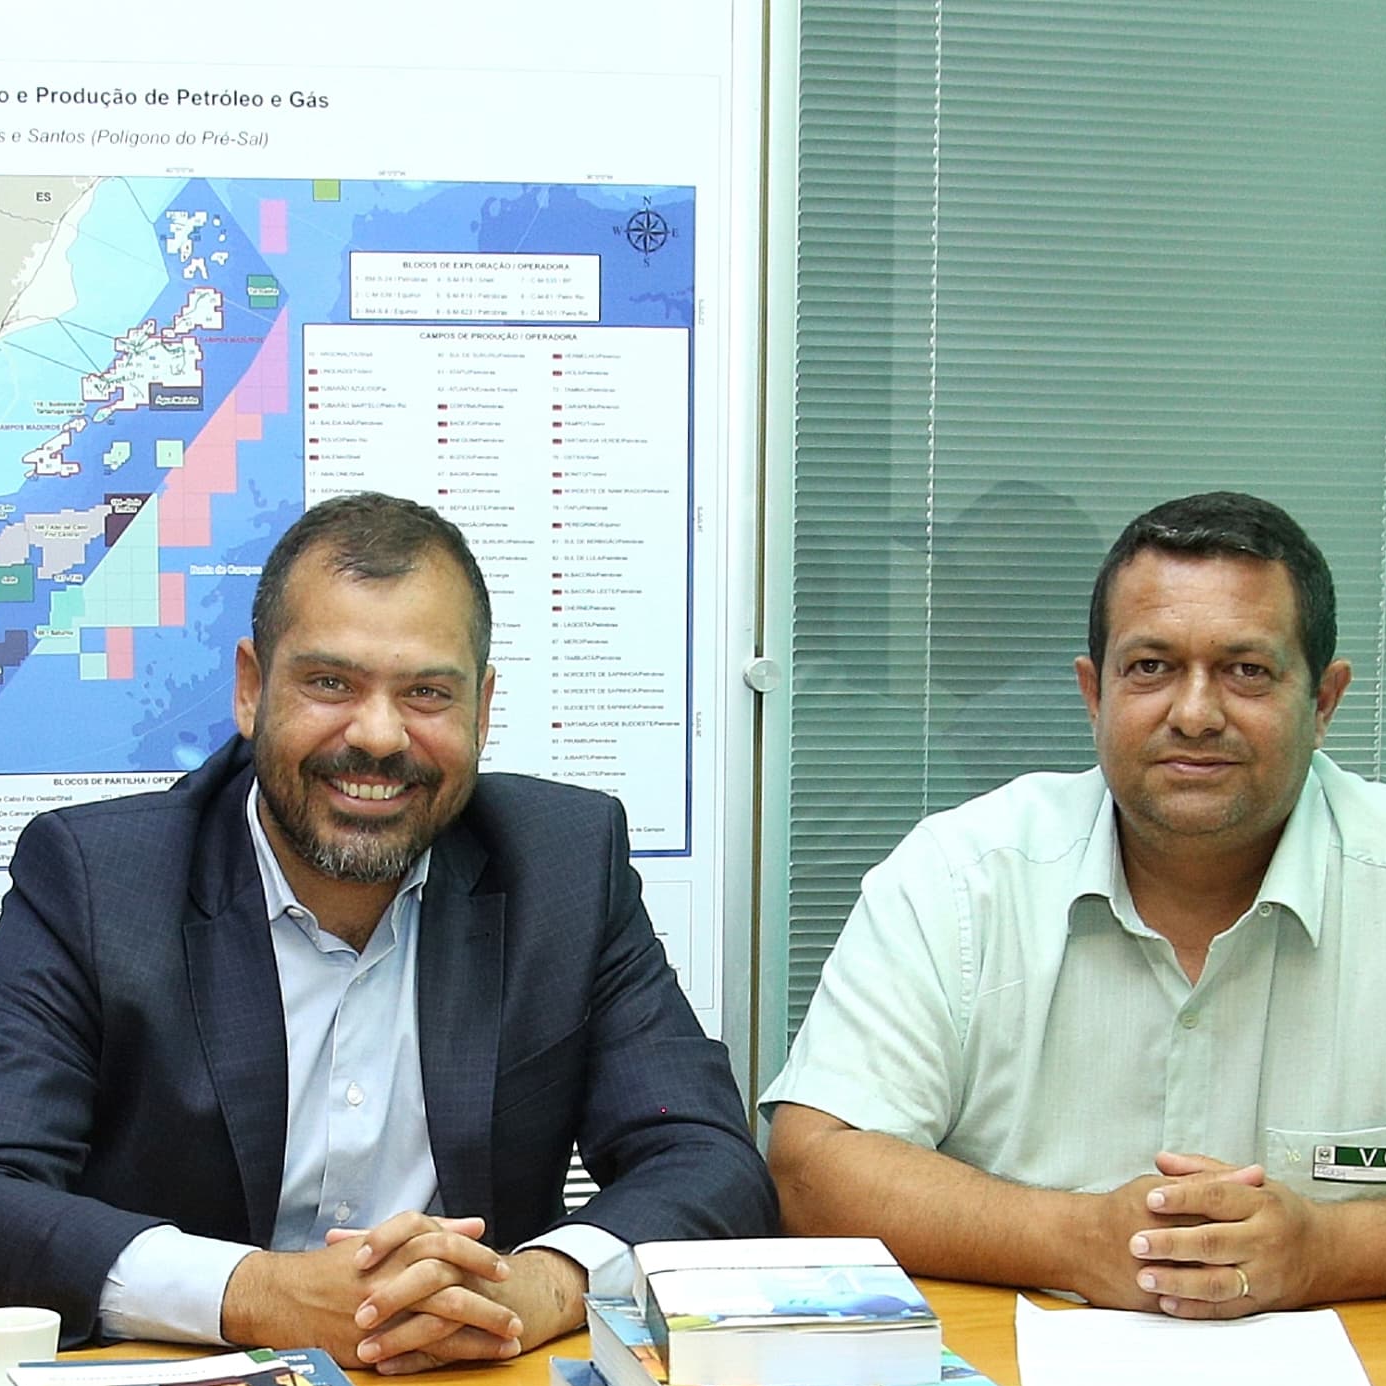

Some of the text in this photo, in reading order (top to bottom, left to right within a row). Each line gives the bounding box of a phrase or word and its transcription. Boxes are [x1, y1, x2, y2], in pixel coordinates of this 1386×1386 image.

[17, 91, 28, 103] e
[36, 86, 136, 108] Produção
[145, 88, 169, 105] de
[177, 89, 263, 107] Petróleo
[271, 94, 282, 107] e
[289, 90, 329, 108] Gás
[11, 132, 21, 143] e
[27, 128, 85, 143] Santos
[91, 129, 170, 148] (Polígono
[176, 130, 196, 145] do
[202, 131, 269, 149] Pré-Sal)
[36, 192, 51, 202] ES
[643, 196, 652, 206] N
[672, 228, 679, 238] E
[402, 261, 438, 270] BLOCOS
[453, 261, 511, 271] EXPLORAÇÃO
[517, 263, 570, 271] OPERADORA
[643, 257, 650, 268] S
[419, 332, 456, 340] CAMPOS
[458, 332, 469, 340] DE
[471, 331, 519, 342] PRODUÇÃO
[525, 333, 578, 341] OPERADORA
[53, 777, 89, 786] BLOCOS
[91, 777, 103, 786] DE
[104, 777, 145, 785] PARTILHA
